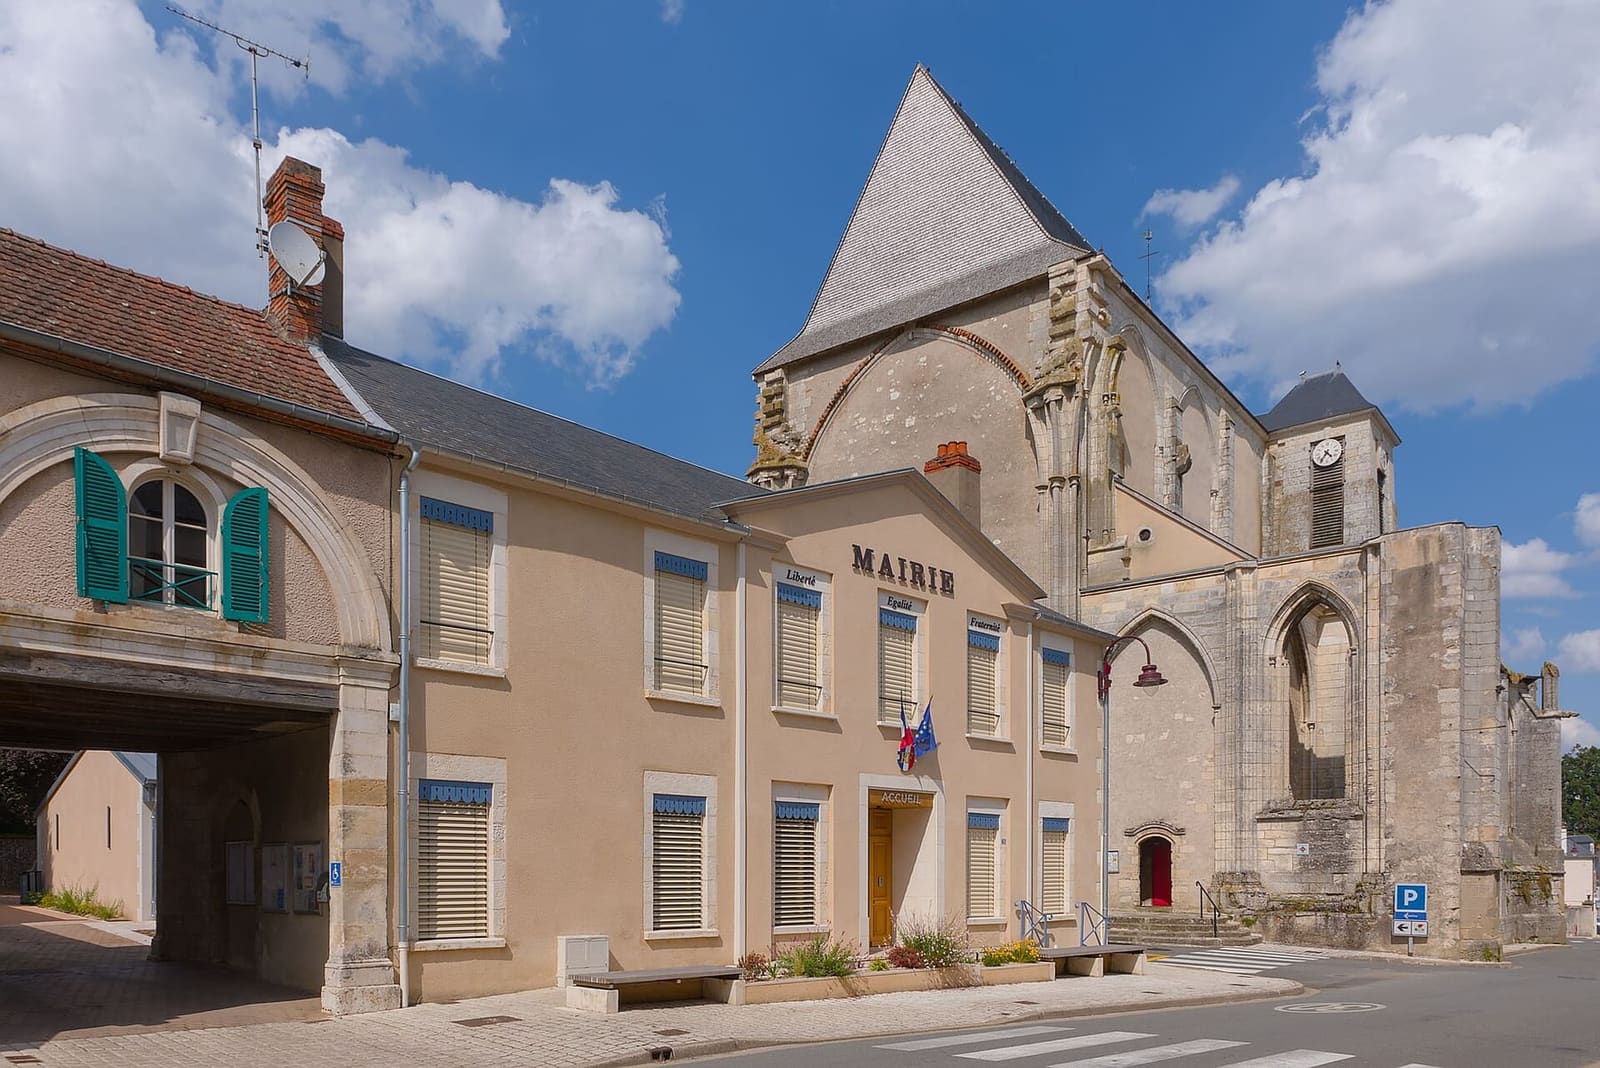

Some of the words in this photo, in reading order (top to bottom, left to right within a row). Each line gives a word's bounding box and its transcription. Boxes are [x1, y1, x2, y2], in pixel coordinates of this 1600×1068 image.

[852, 544, 954, 593] MAIRIE
[786, 569, 816, 587] Liberté
[887, 596, 913, 611] Egalité
[970, 617, 1000, 633] Fraternité
[881, 792, 921, 804] ACCUEIL
[1403, 889, 1418, 906] P
